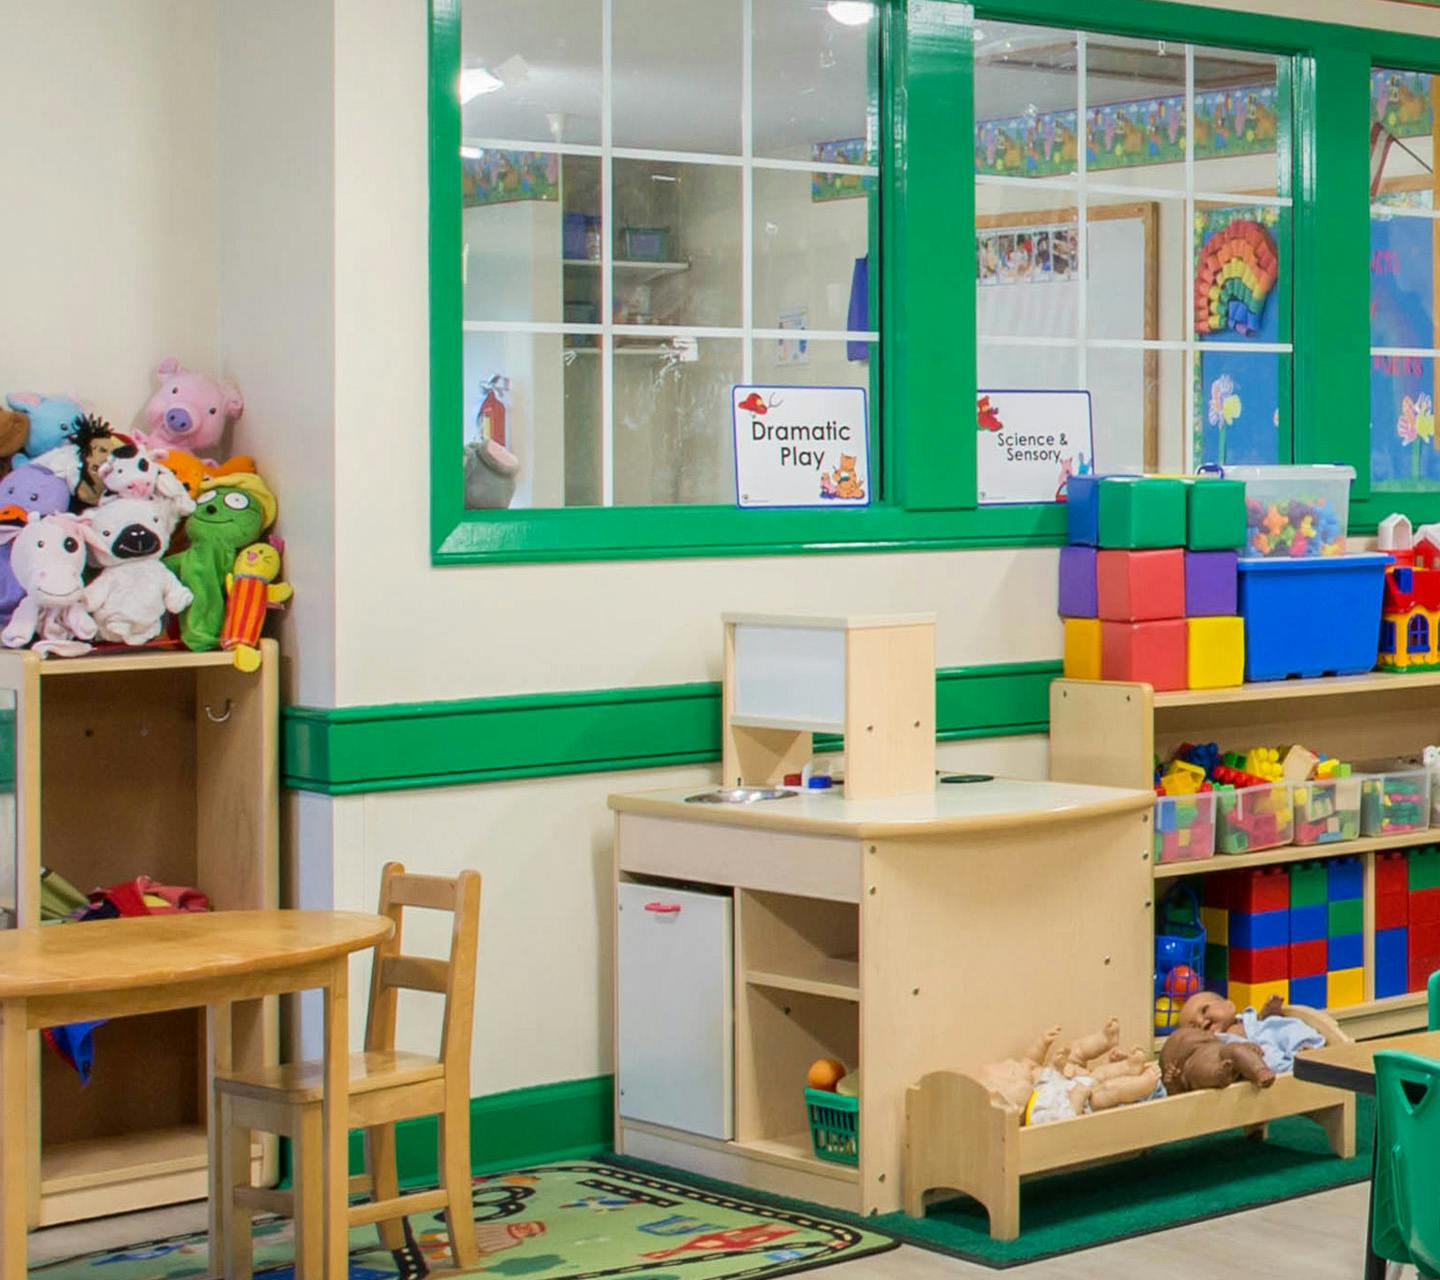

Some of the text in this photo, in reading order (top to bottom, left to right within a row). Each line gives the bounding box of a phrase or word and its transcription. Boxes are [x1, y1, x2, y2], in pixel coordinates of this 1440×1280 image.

[752, 421, 851, 441] Dramatic
[998, 432, 1068, 447] Science &
[781, 447, 825, 470] Play
[1007, 448, 1061, 463] Sensory
